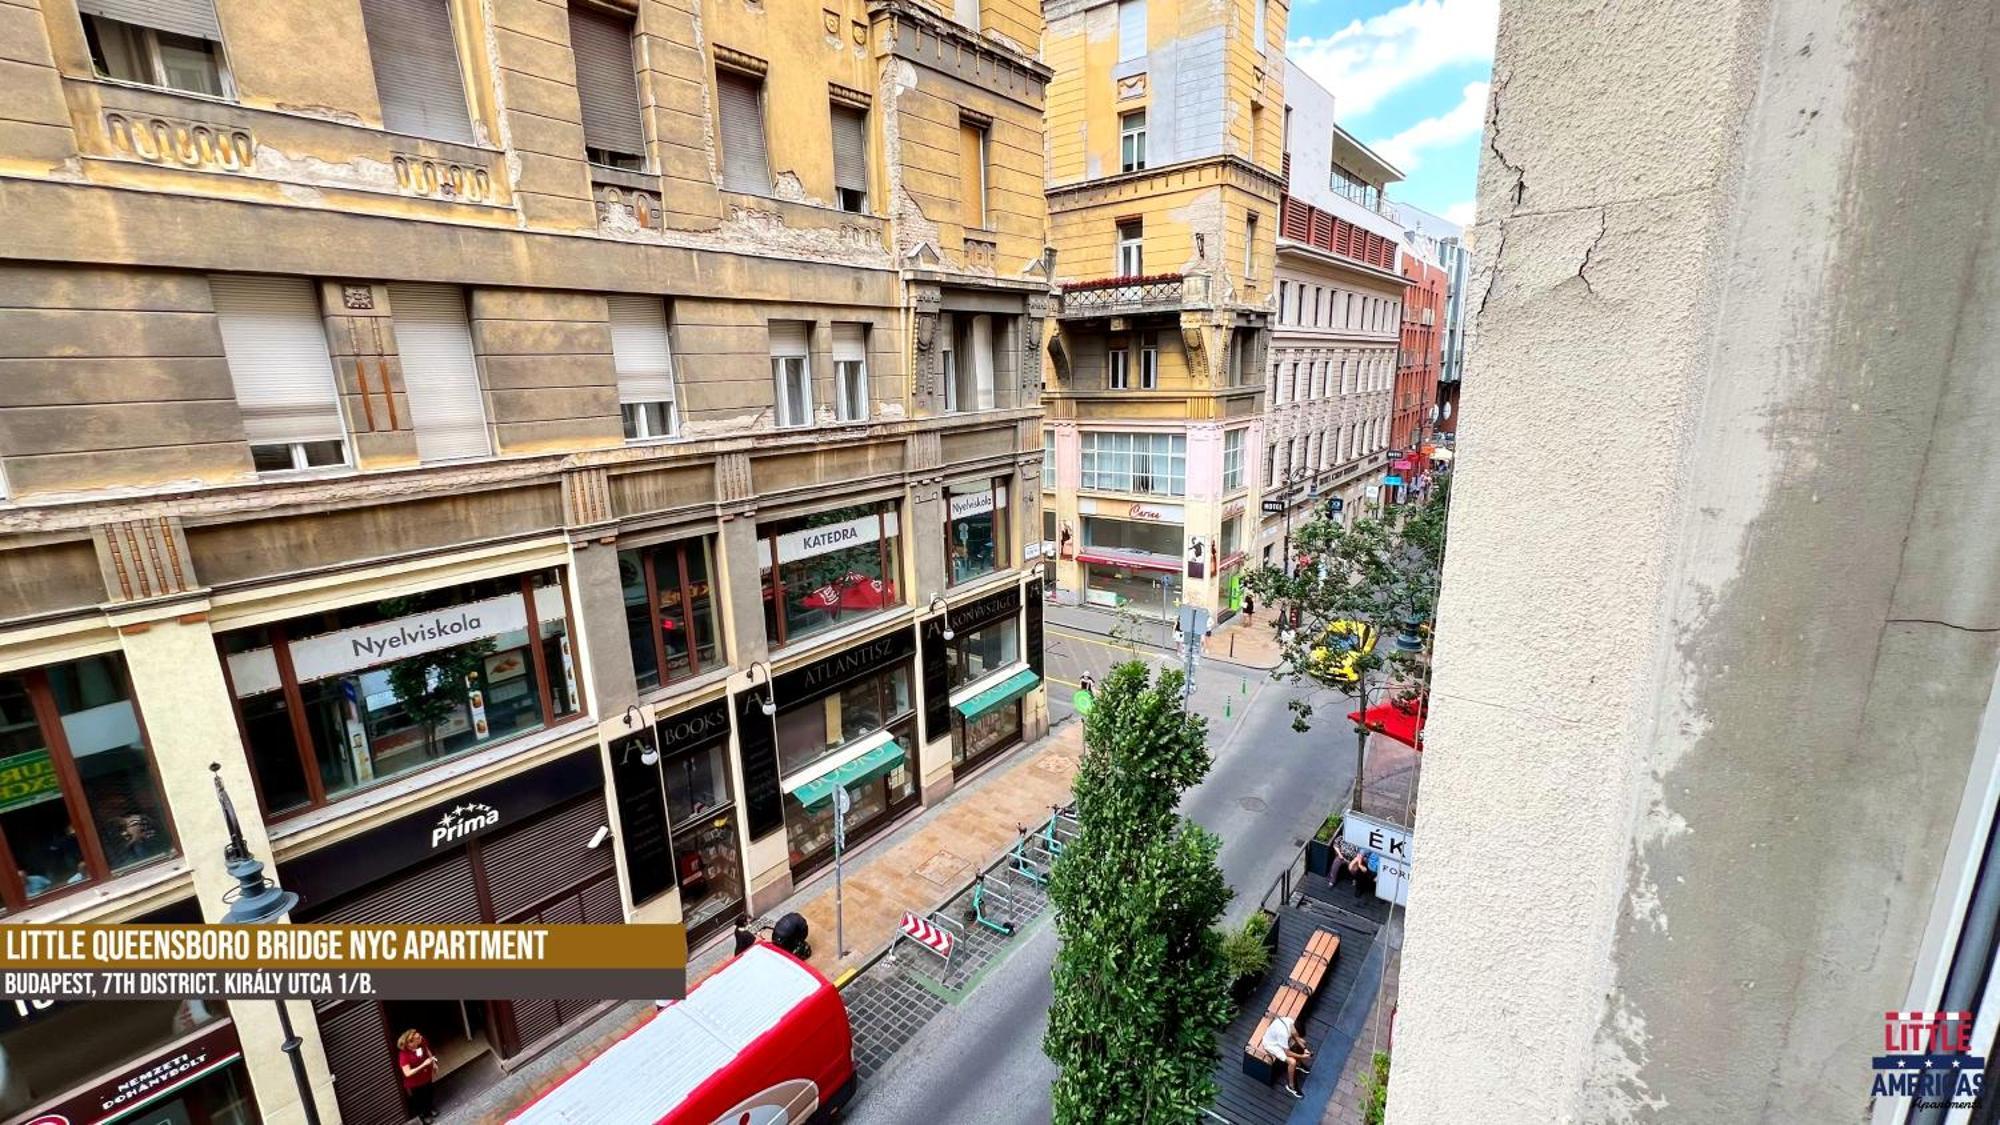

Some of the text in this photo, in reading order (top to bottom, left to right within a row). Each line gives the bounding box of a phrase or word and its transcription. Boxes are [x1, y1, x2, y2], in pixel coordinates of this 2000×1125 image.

[1263, 502, 1283, 511] HOTEL
[803, 527, 858, 550] KATEDRA
[352, 613, 480, 657] Nyelviskola
[804, 638, 892, 688] ATLANTISZ
[664, 708, 725, 745] BOOKS
[118, 1054, 188, 1092] NEMZETI
